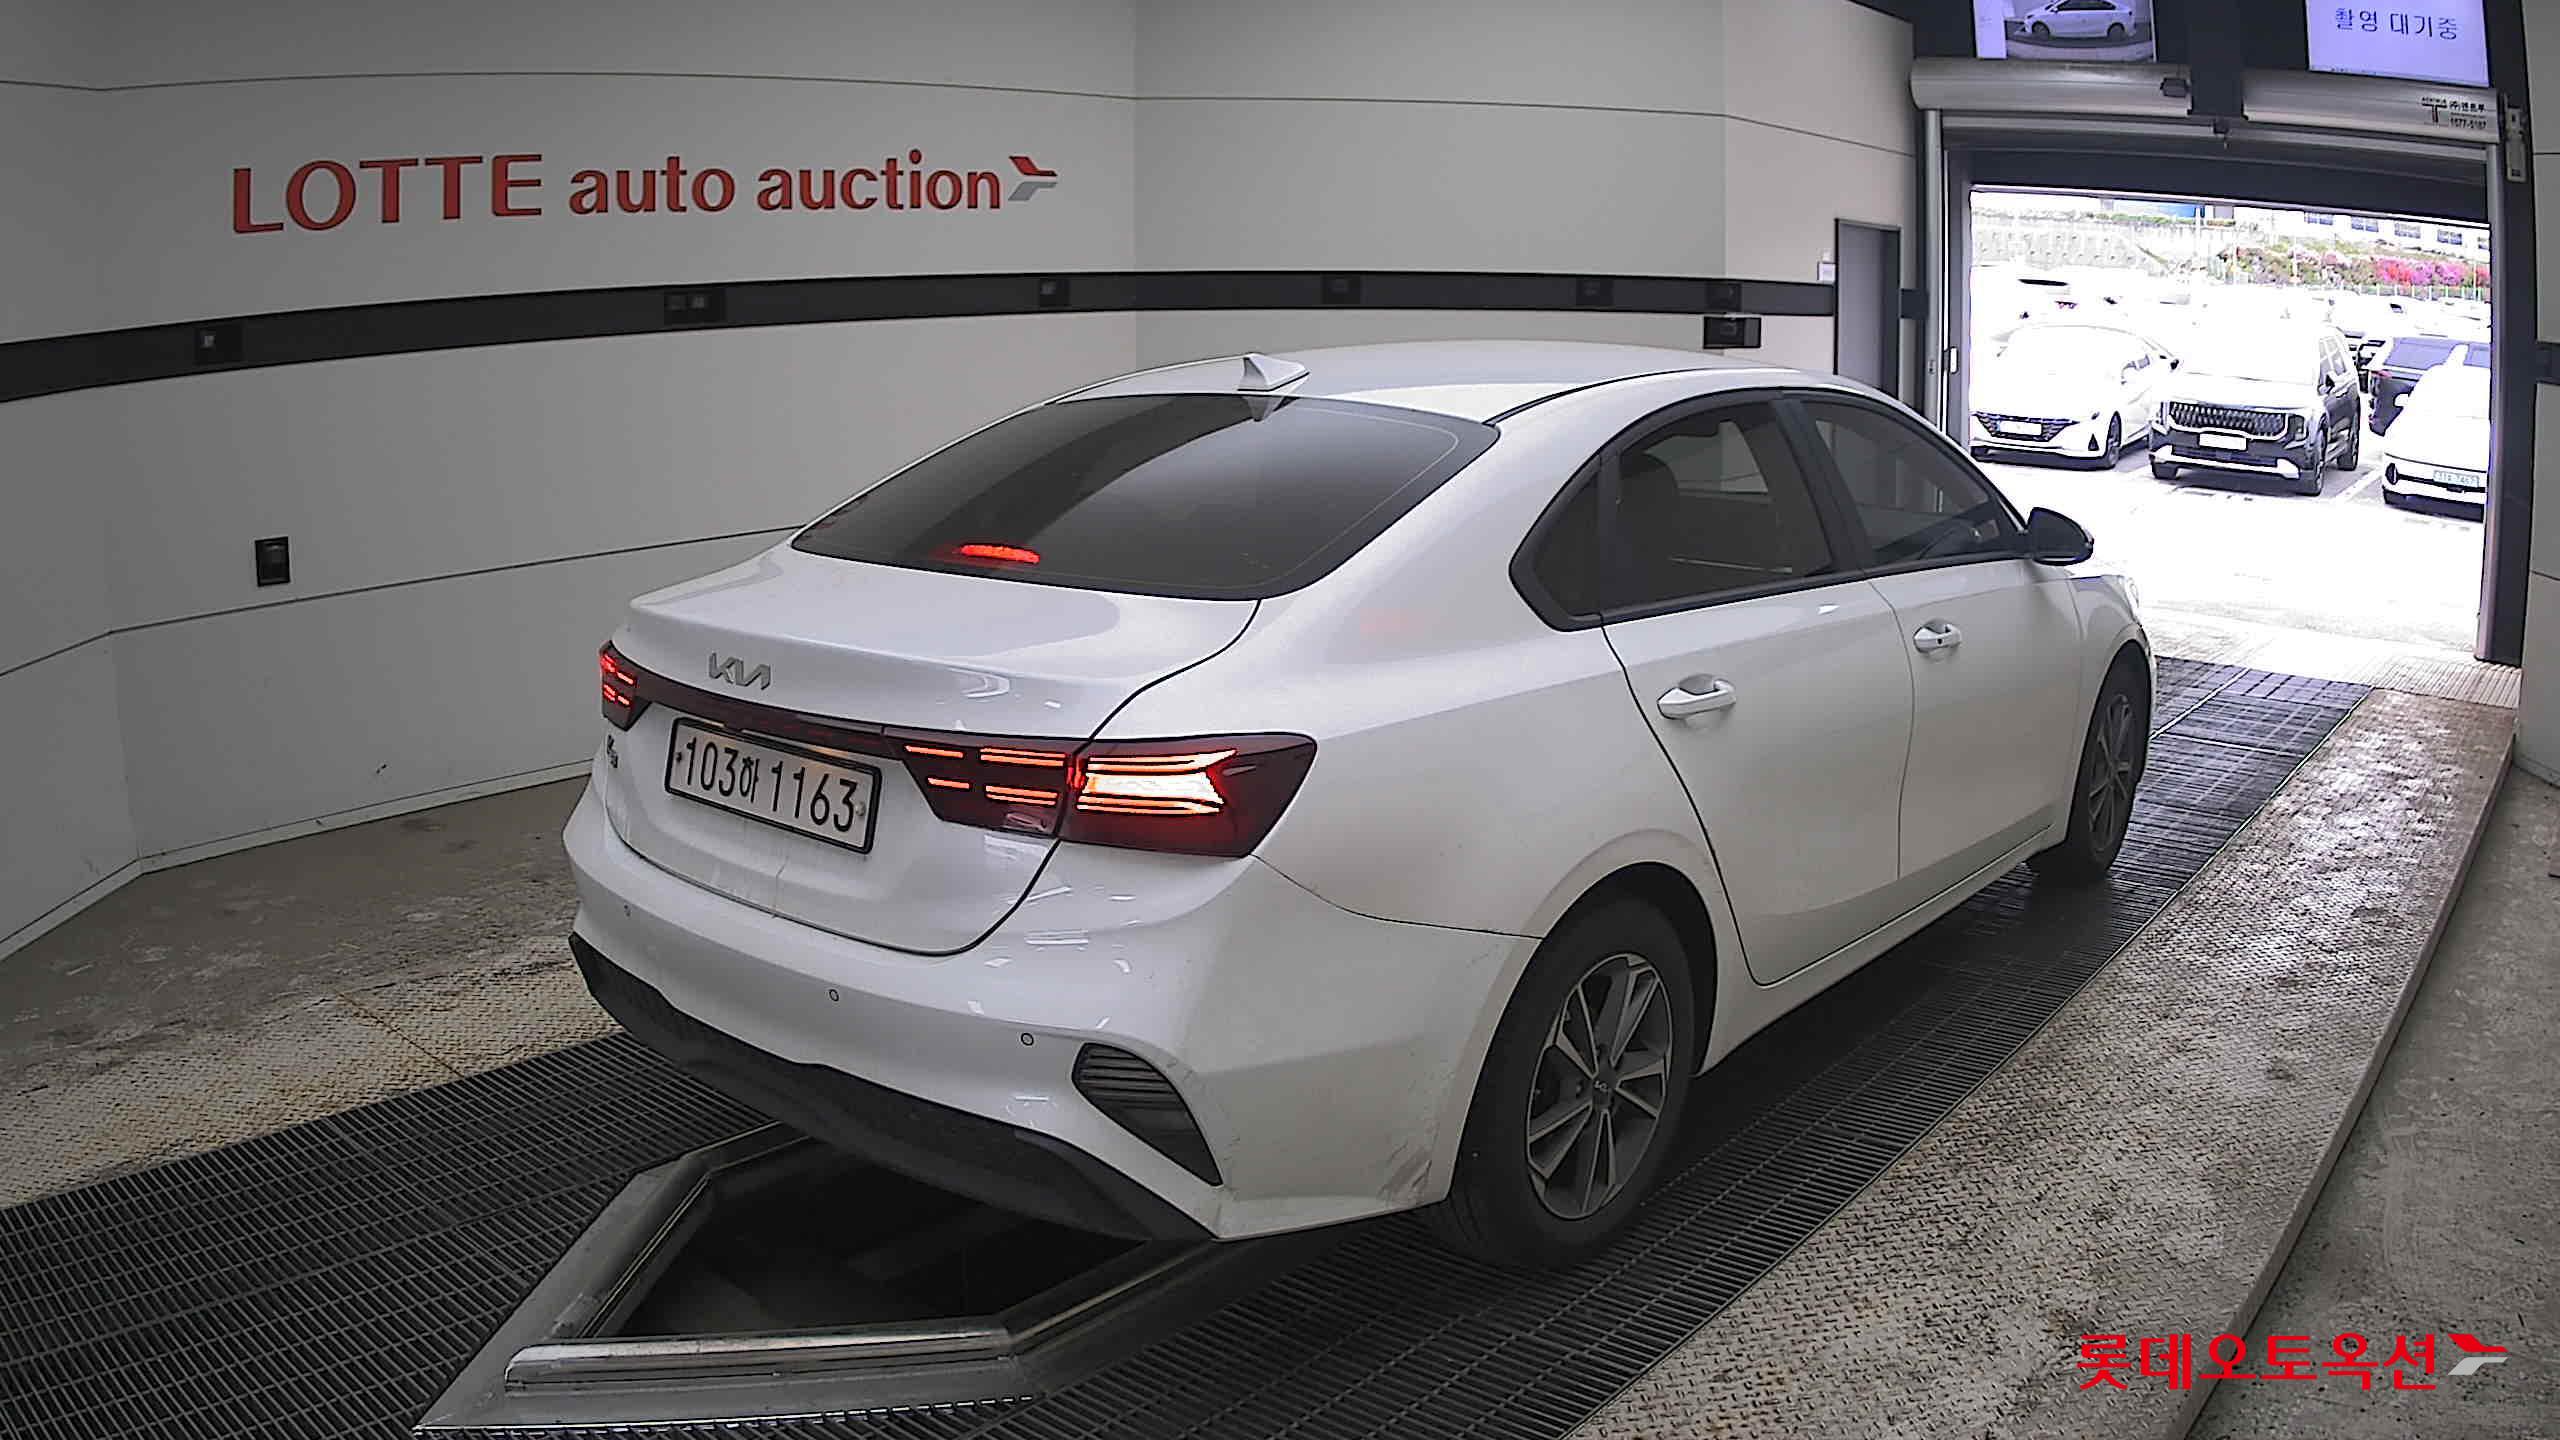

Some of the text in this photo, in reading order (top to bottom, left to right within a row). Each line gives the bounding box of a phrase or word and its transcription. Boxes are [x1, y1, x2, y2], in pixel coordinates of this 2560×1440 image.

[2335, 7, 2458, 41] 촬영 대기중
[232, 148, 1001, 234] LOTTE auto auction
[771, 760, 859, 832] 1163
